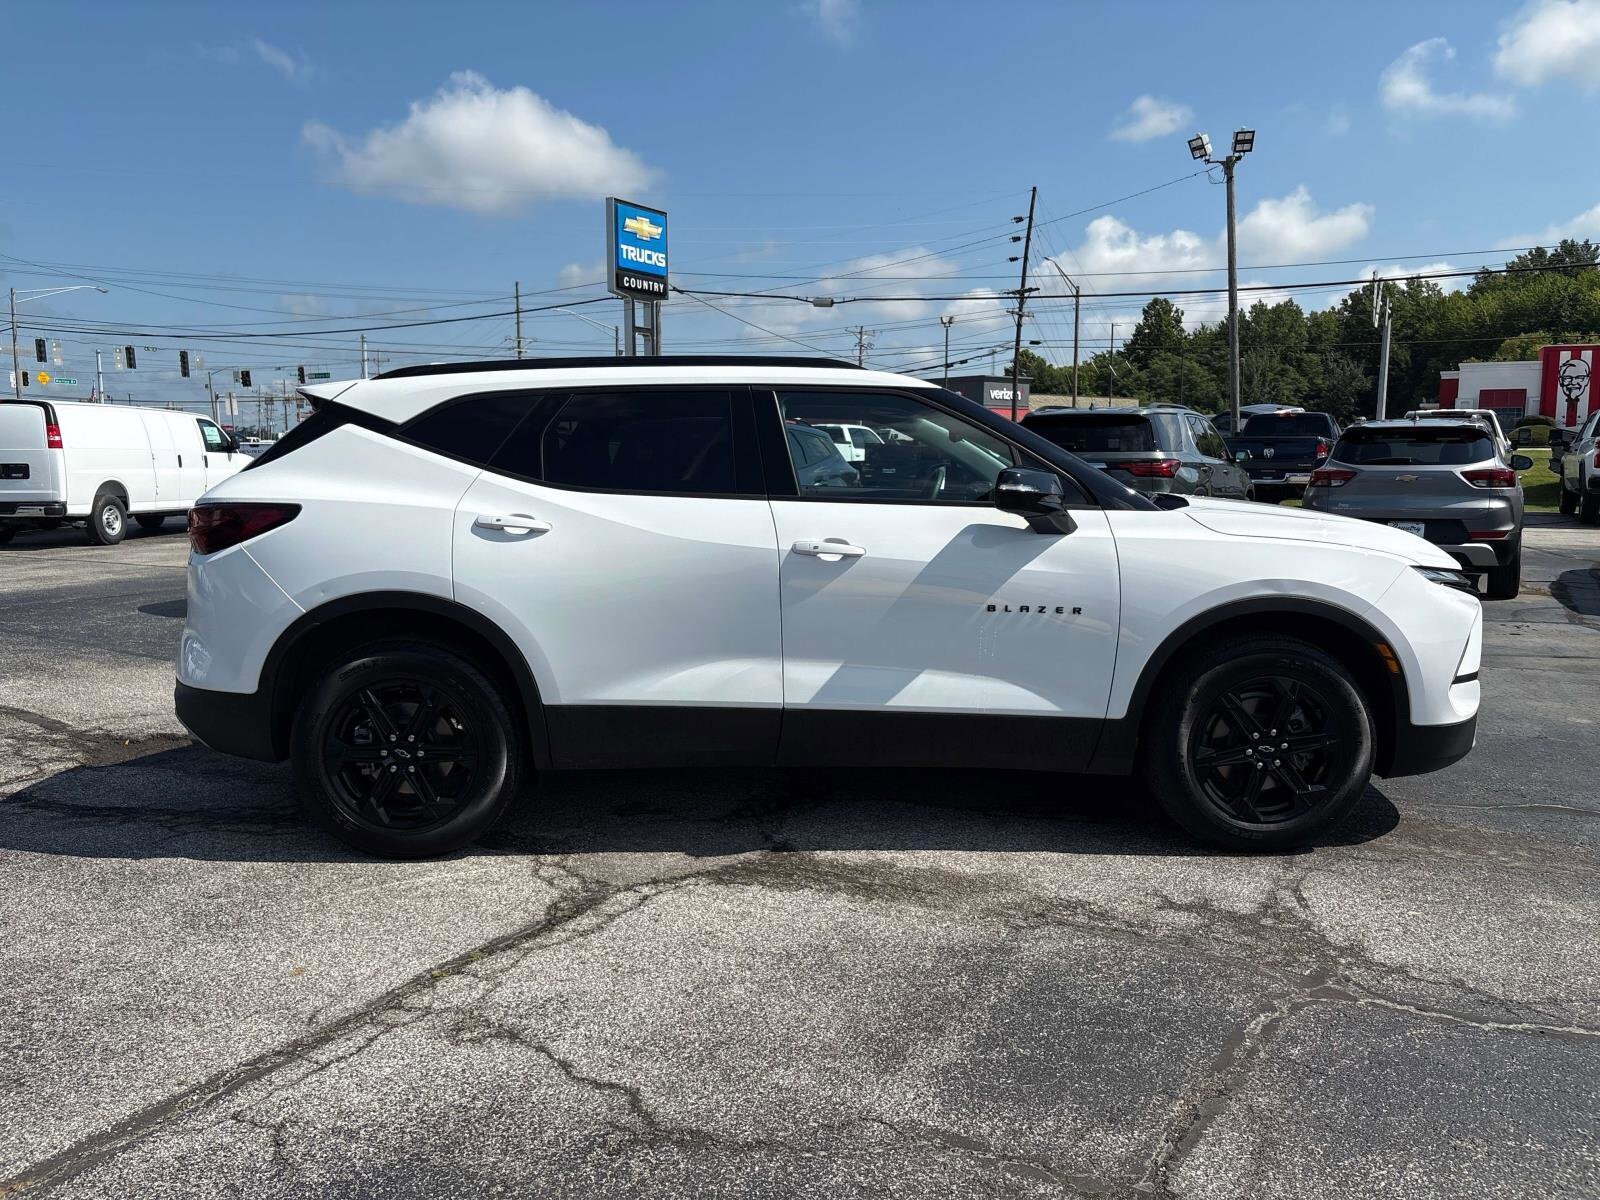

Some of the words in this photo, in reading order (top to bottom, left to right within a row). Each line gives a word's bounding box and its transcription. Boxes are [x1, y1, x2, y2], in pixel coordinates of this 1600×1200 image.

[620, 244, 666, 267] TRUCKS
[623, 276, 664, 293] COUNTRY
[987, 605, 1082, 615] BLAZER
